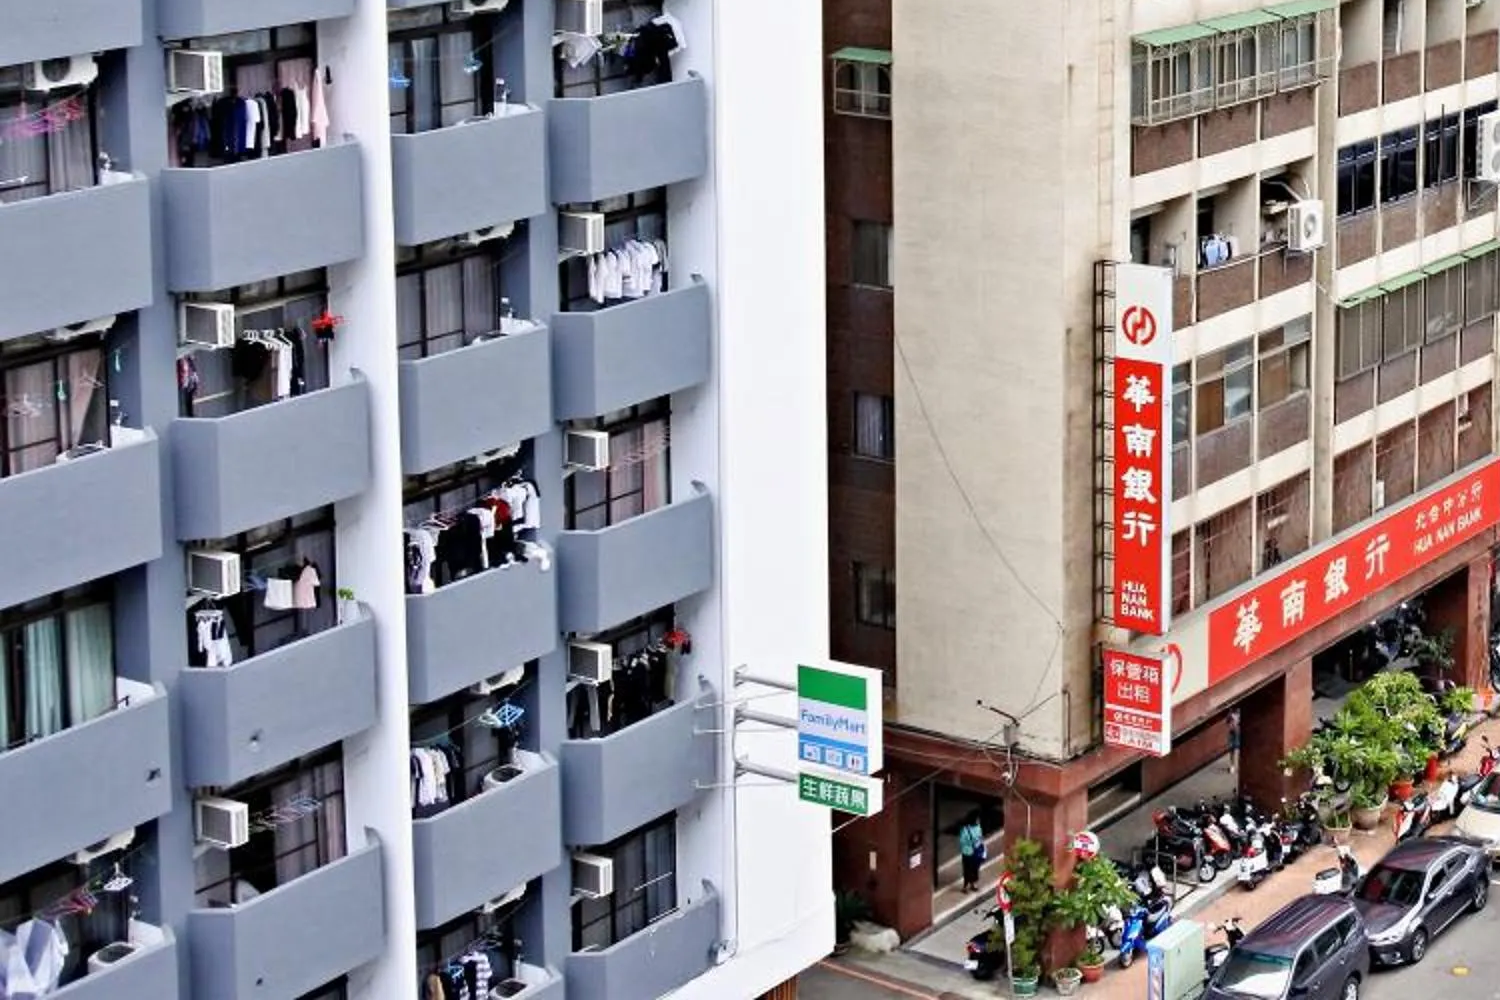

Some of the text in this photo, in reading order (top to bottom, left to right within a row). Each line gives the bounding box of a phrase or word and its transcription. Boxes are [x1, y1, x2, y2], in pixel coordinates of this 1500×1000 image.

[1121, 374, 1156, 547] 華南銀行
[1414, 507, 1482, 555] HUA NAN BANK
[1121, 580, 1147, 594] HUA
[1121, 592, 1147, 607] NAN
[1234, 534, 1391, 653] 華南銀行
[1121, 604, 1154, 620] BANK
[801, 709, 865, 734] FamilyMart
[802, 778, 865, 808] 生鮮蔬果
